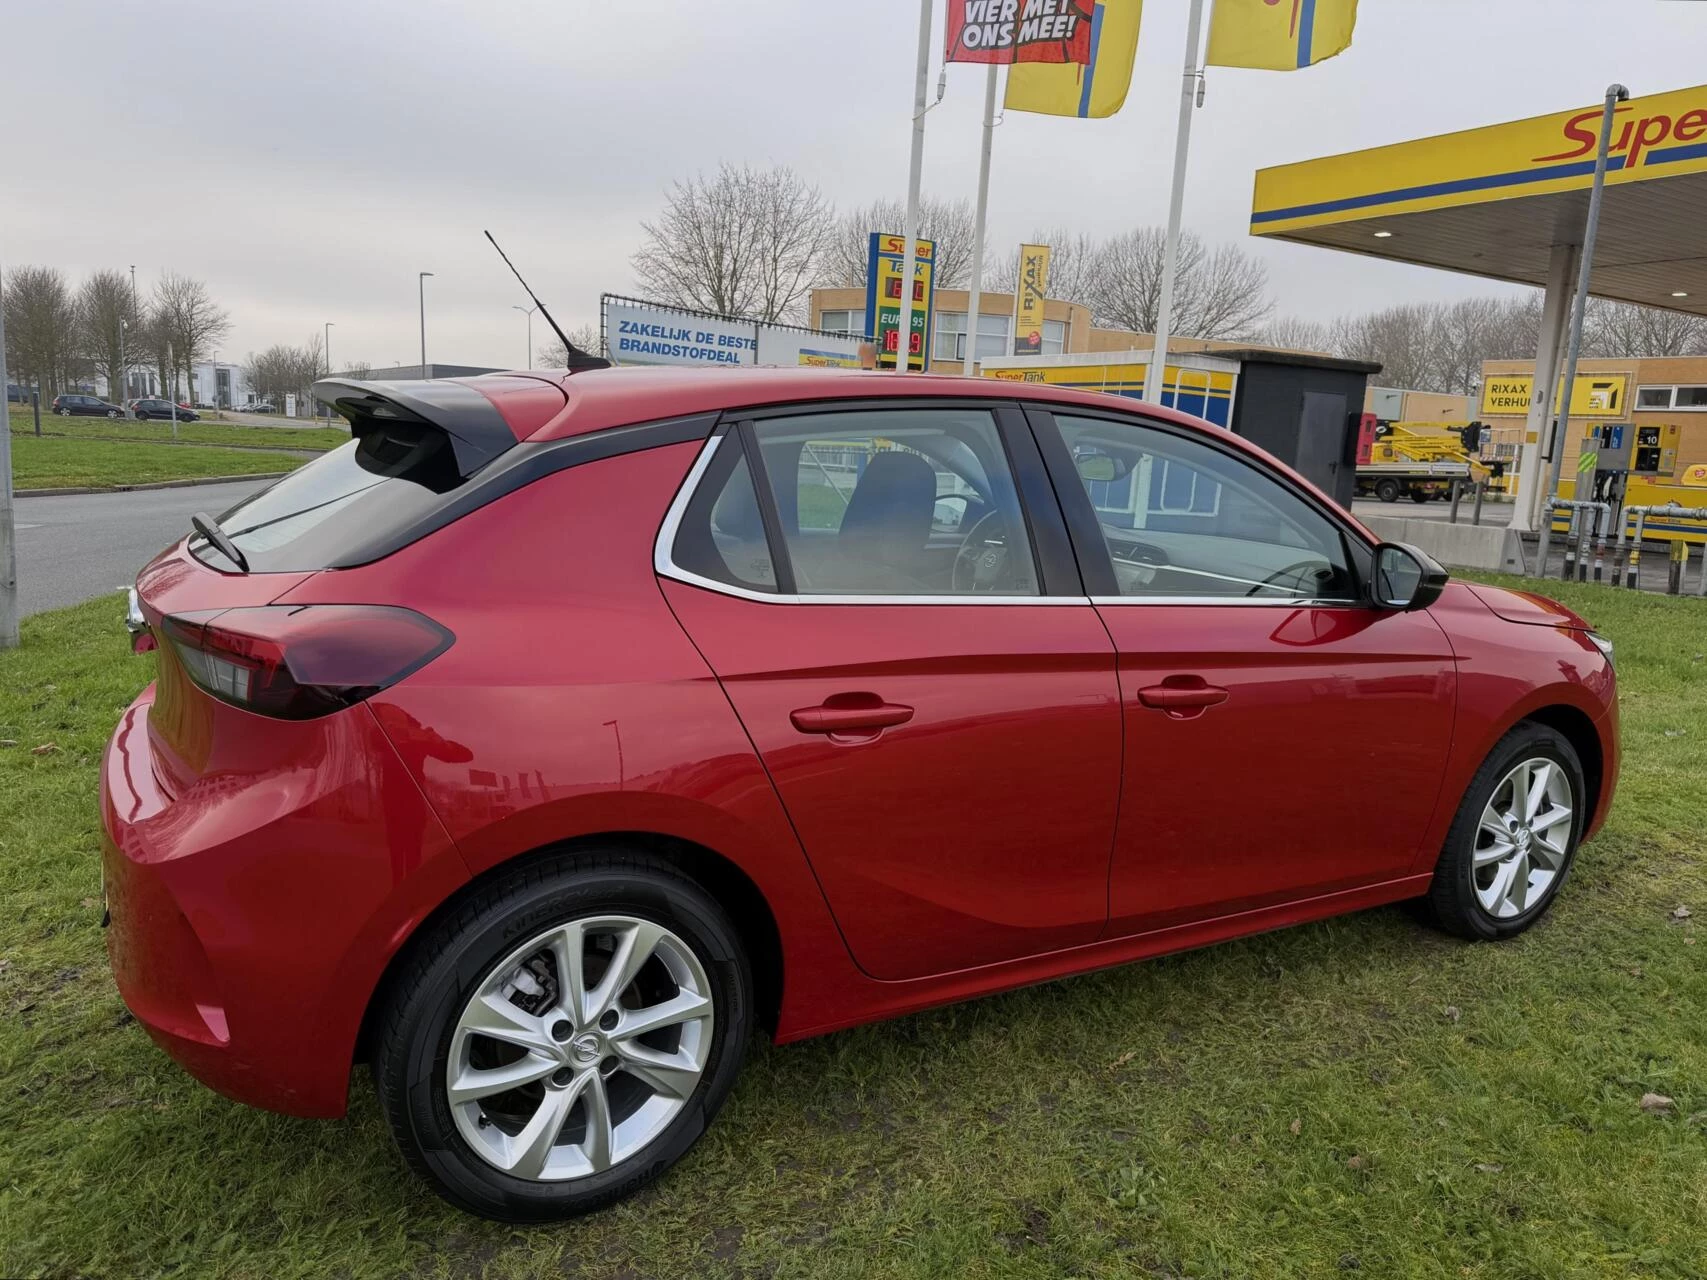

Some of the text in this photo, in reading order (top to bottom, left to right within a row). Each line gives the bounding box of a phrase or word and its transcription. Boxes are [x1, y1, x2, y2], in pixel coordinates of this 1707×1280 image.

[965, 0, 1018, 23] VIER
[963, 15, 1077, 48] ONS MEE!
[880, 238, 931, 257] Suer
[888, 260, 923, 276] Tak
[911, 317, 924, 327] 95
[619, 320, 758, 350] ZAKELIJK DE BESTE
[619, 338, 741, 364] BRANDSTOFDEAL
[1491, 384, 1528, 394] RIXAX
[1491, 397, 1531, 407] VERHU
[1646, 436, 1658, 445] 10
